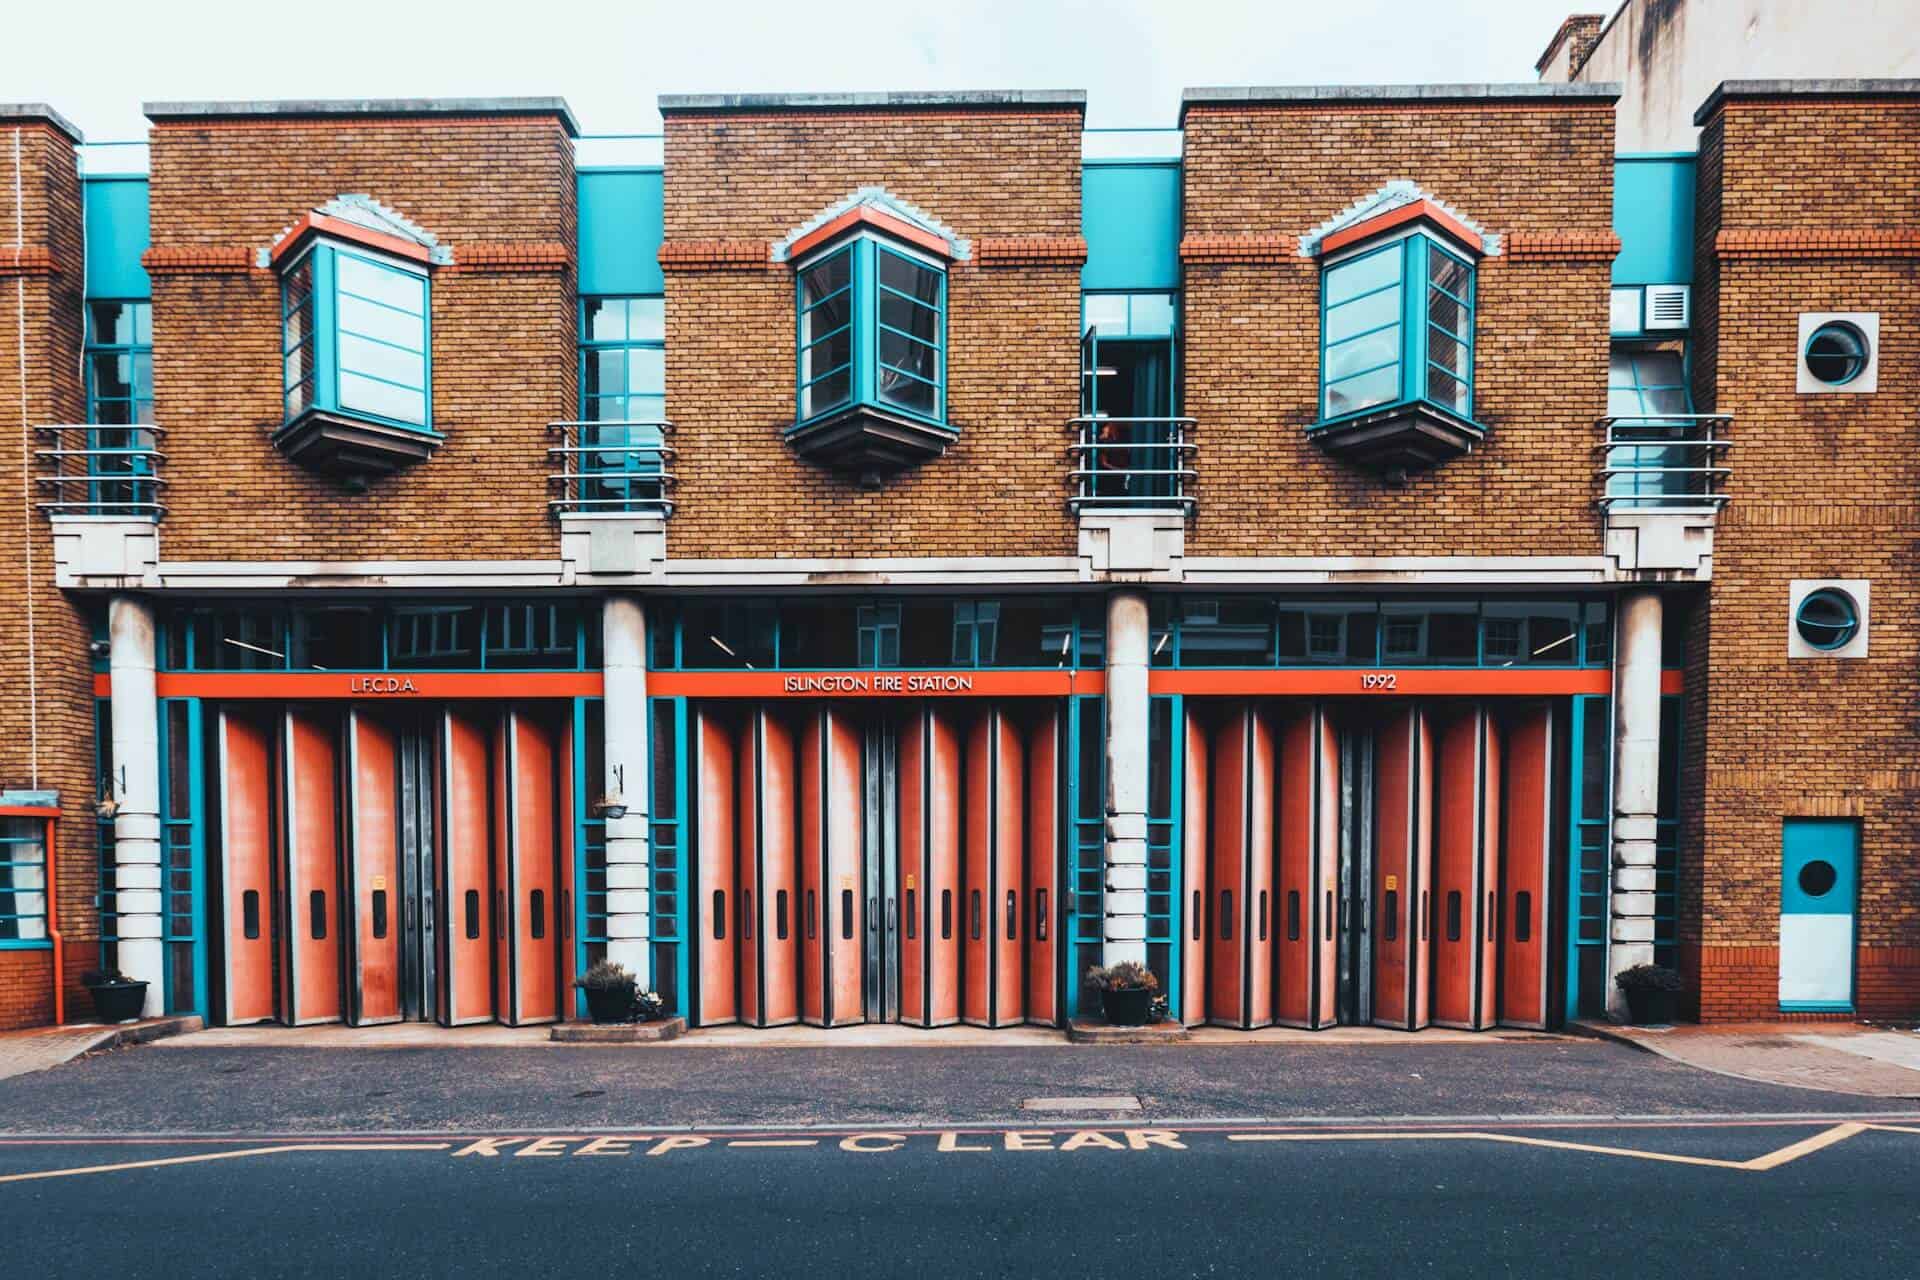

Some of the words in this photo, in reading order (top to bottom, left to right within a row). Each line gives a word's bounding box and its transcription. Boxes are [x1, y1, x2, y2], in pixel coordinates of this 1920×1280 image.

[784, 676, 868, 691] ISLINGTON
[874, 676, 902, 690] FIRE
[907, 676, 972, 691] STATION
[1362, 674, 1396, 689] 1992
[451, 1137, 710, 1156] KEEP
[839, 1130, 1188, 1151] CLEAR
